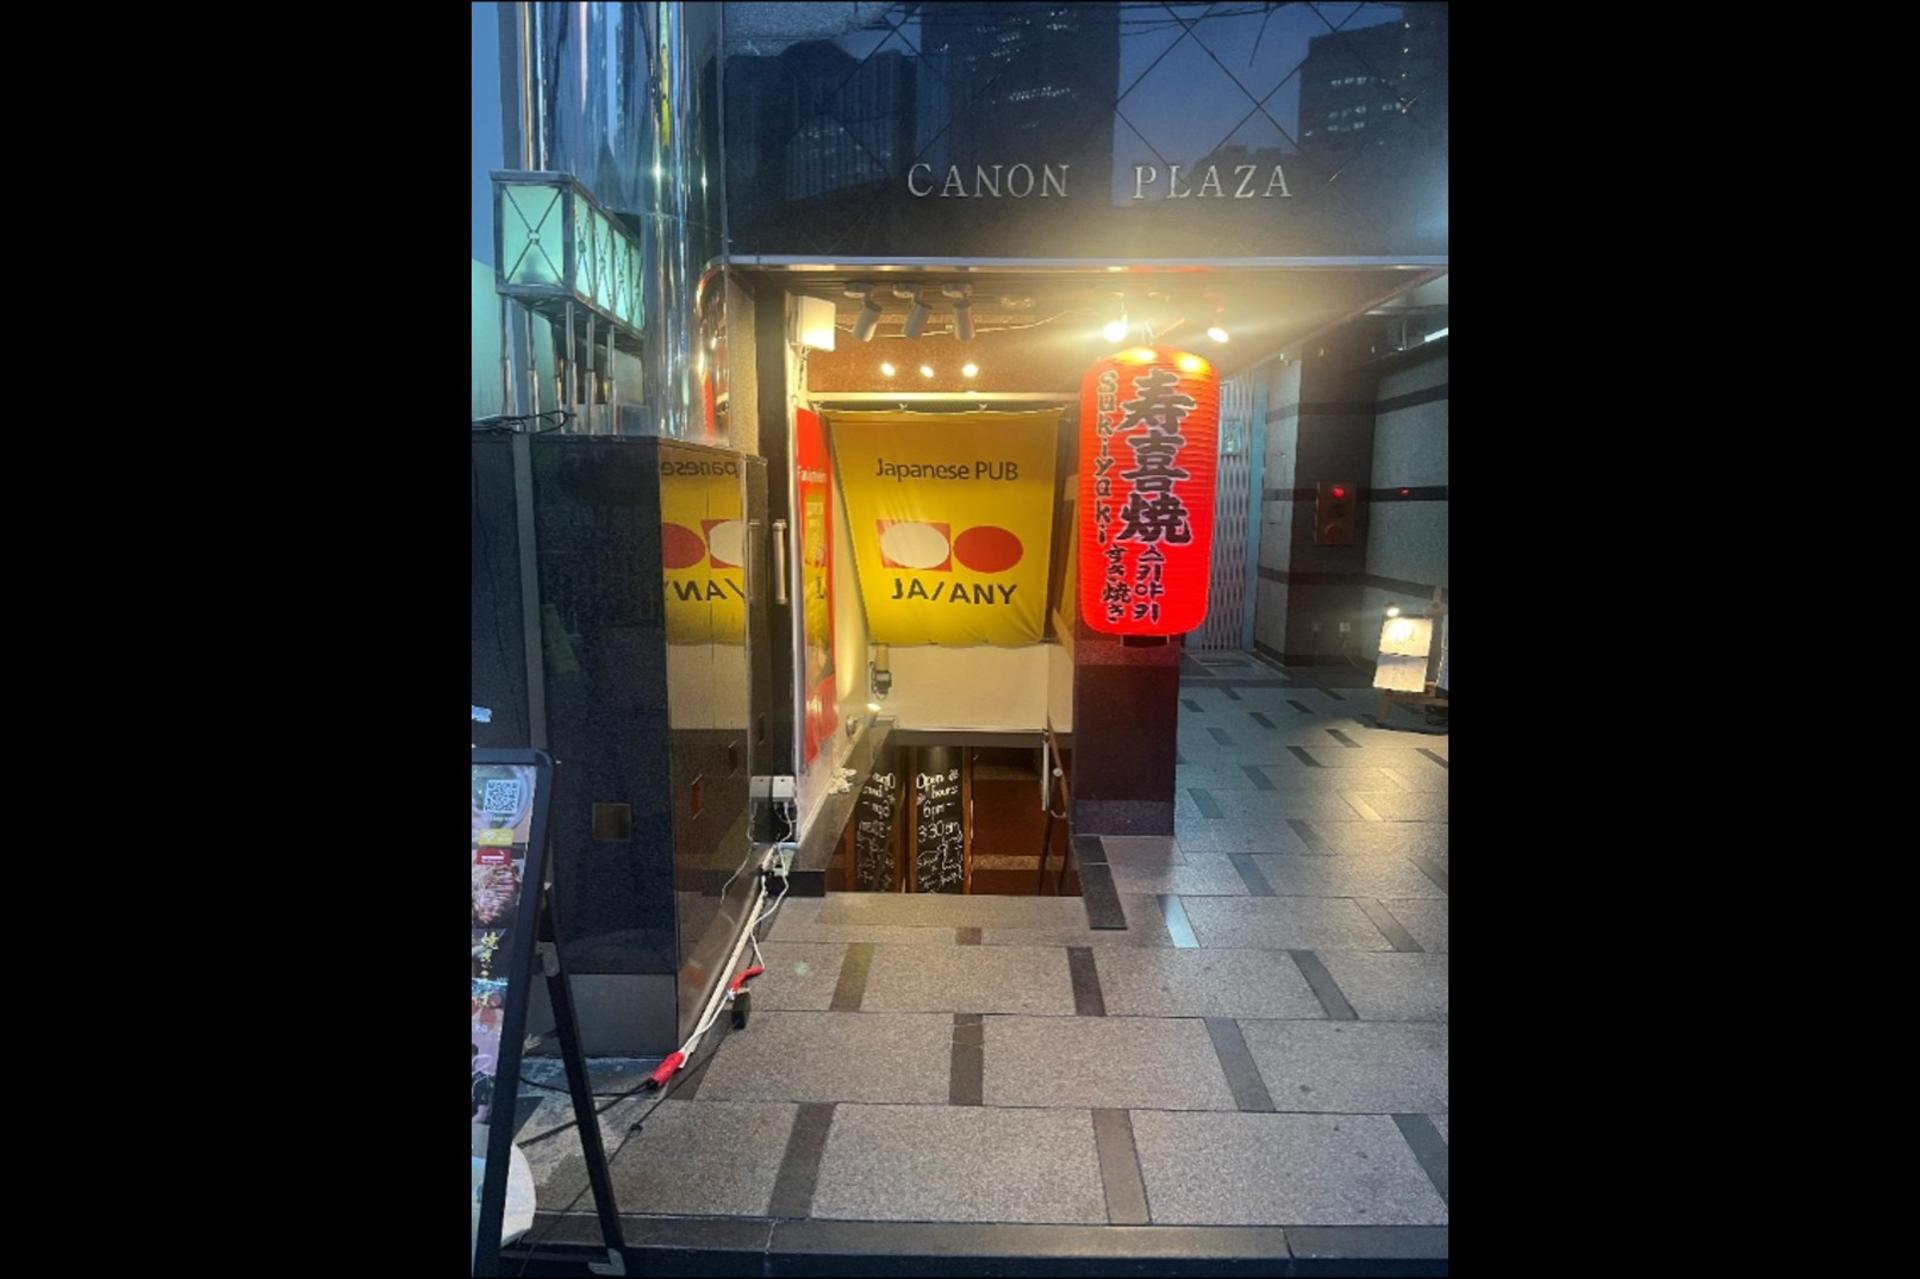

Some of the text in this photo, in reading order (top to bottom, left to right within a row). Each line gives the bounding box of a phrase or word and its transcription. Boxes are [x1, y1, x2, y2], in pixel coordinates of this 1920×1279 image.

[907, 163, 1292, 199] CANON PLAZA
[876, 458, 1019, 482] Japanese PUB
[1093, 369, 1119, 545] Sukiyaki
[1118, 367, 1198, 546] 寿喜焼
[891, 578, 1018, 605] JA/ANY
[1132, 543, 1166, 624] 스키야키
[916, 772, 944, 792] Open
